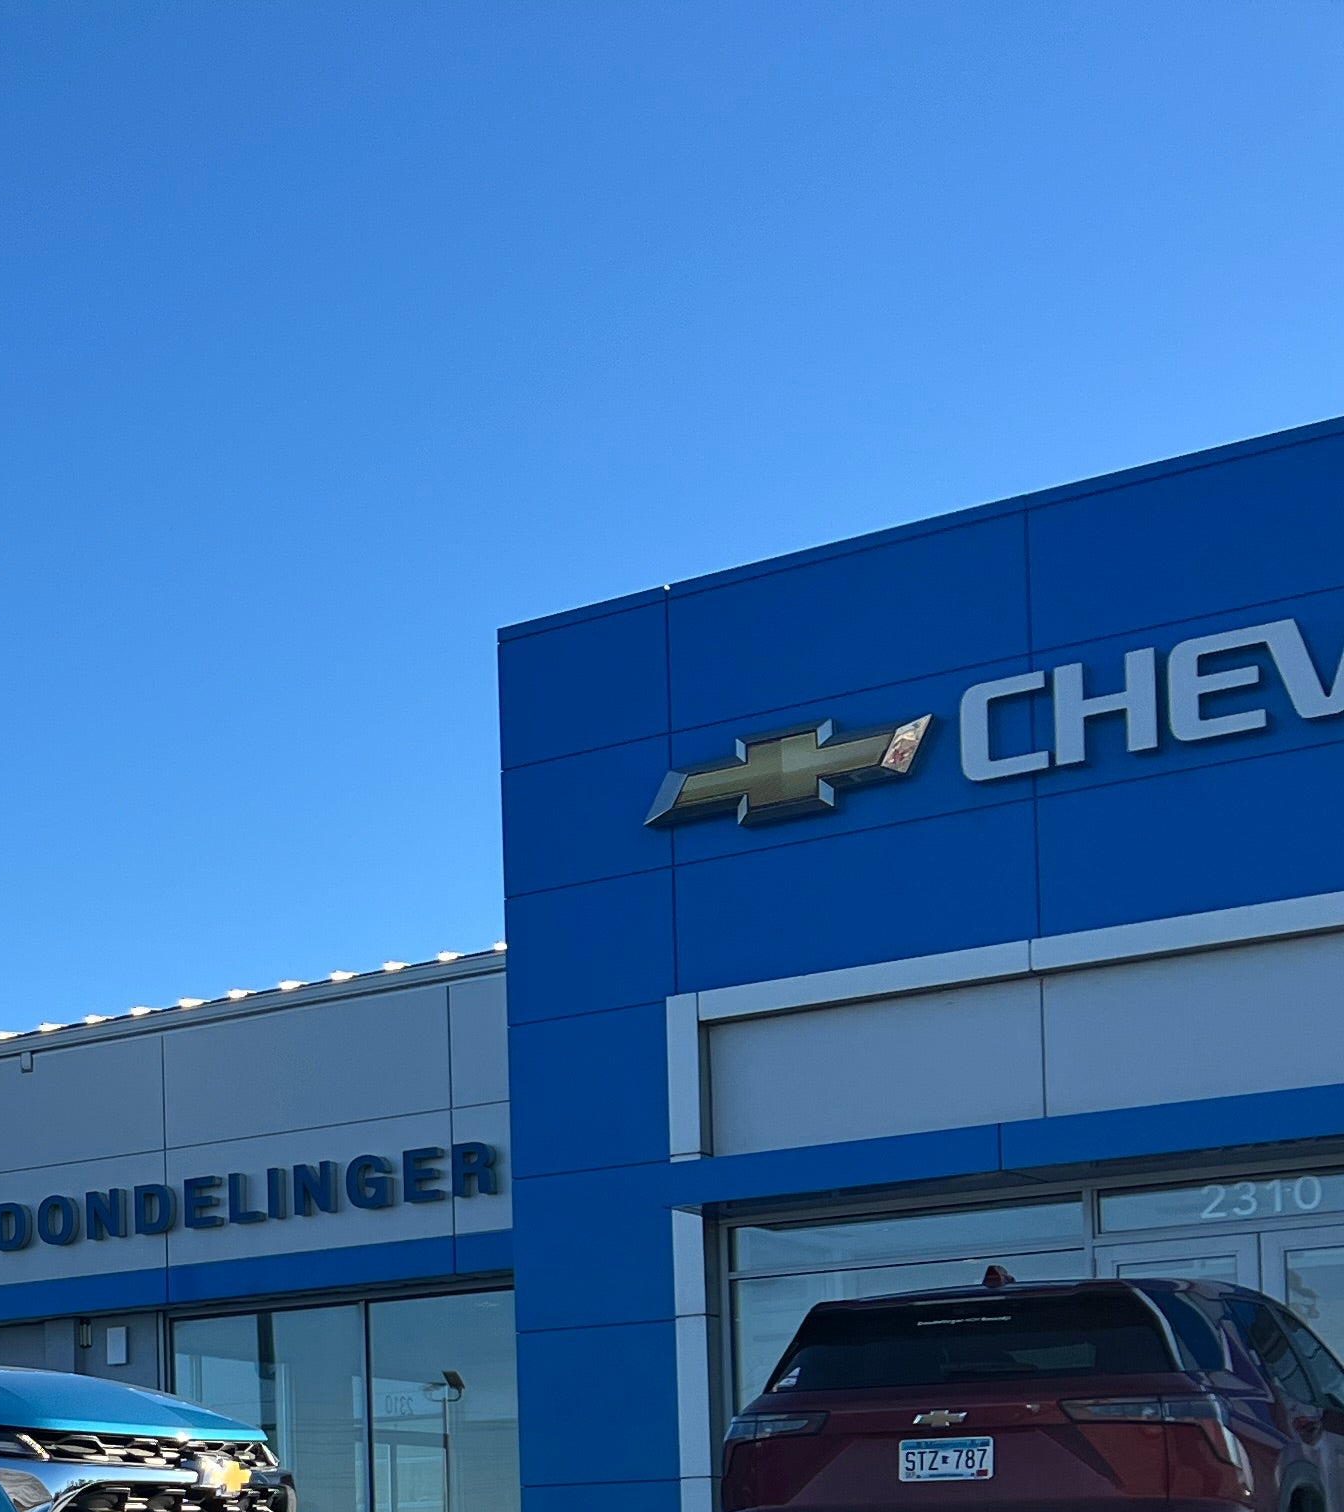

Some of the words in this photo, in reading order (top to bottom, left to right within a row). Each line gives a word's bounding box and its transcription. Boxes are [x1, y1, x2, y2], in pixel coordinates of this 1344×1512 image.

[961, 618, 1344, 781] CHEV
[1200, 1176, 1322, 1219] 2310
[905, 1450, 939, 1471] STZ
[953, 1448, 987, 1470] 787
